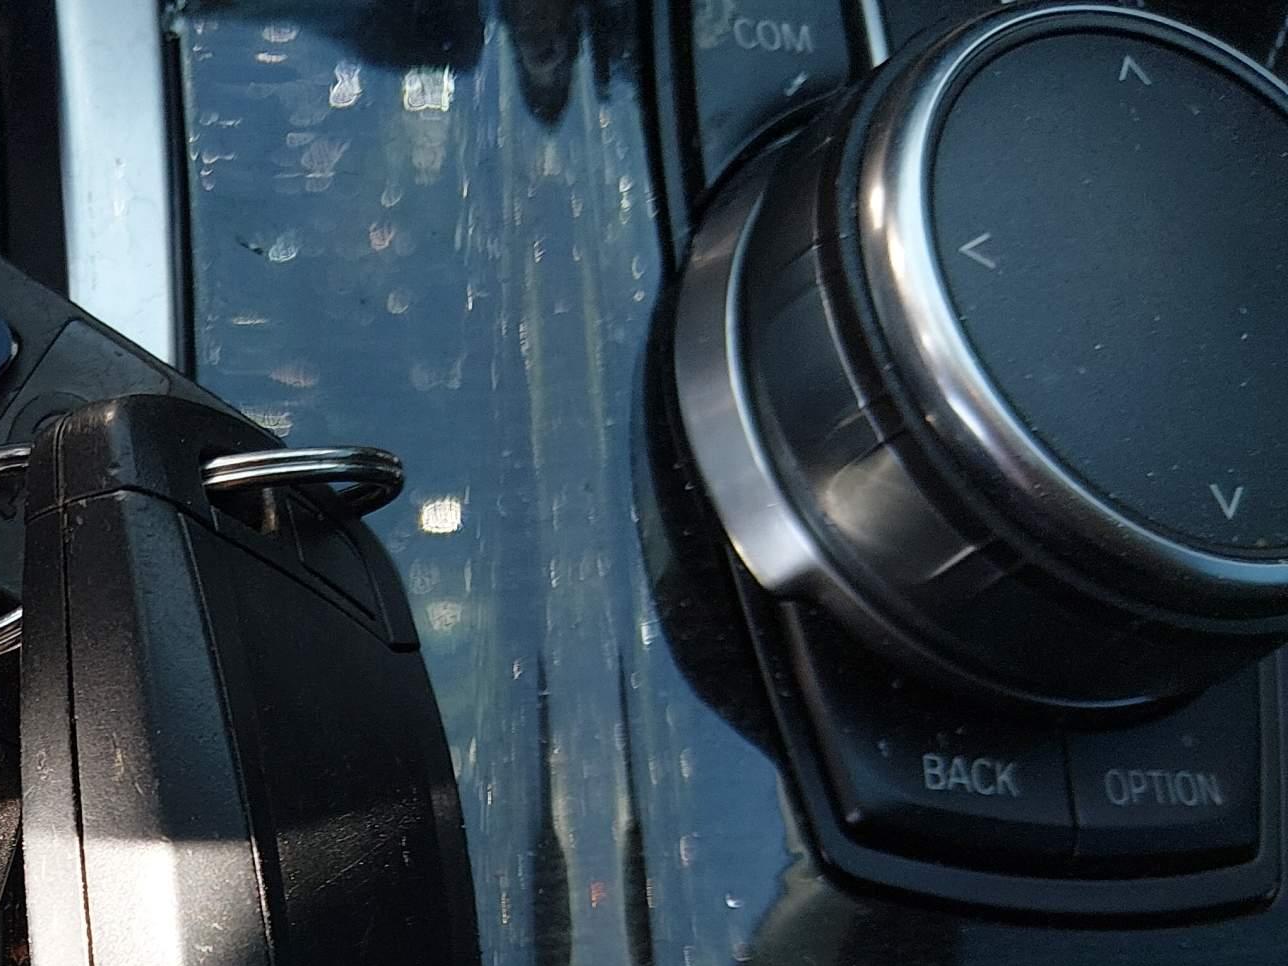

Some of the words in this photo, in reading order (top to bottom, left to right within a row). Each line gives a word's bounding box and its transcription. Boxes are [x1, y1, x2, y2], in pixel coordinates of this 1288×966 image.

[733, 18, 813, 52] COM
[922, 752, 1020, 797] BACK
[1104, 768, 1223, 806] OPTION
